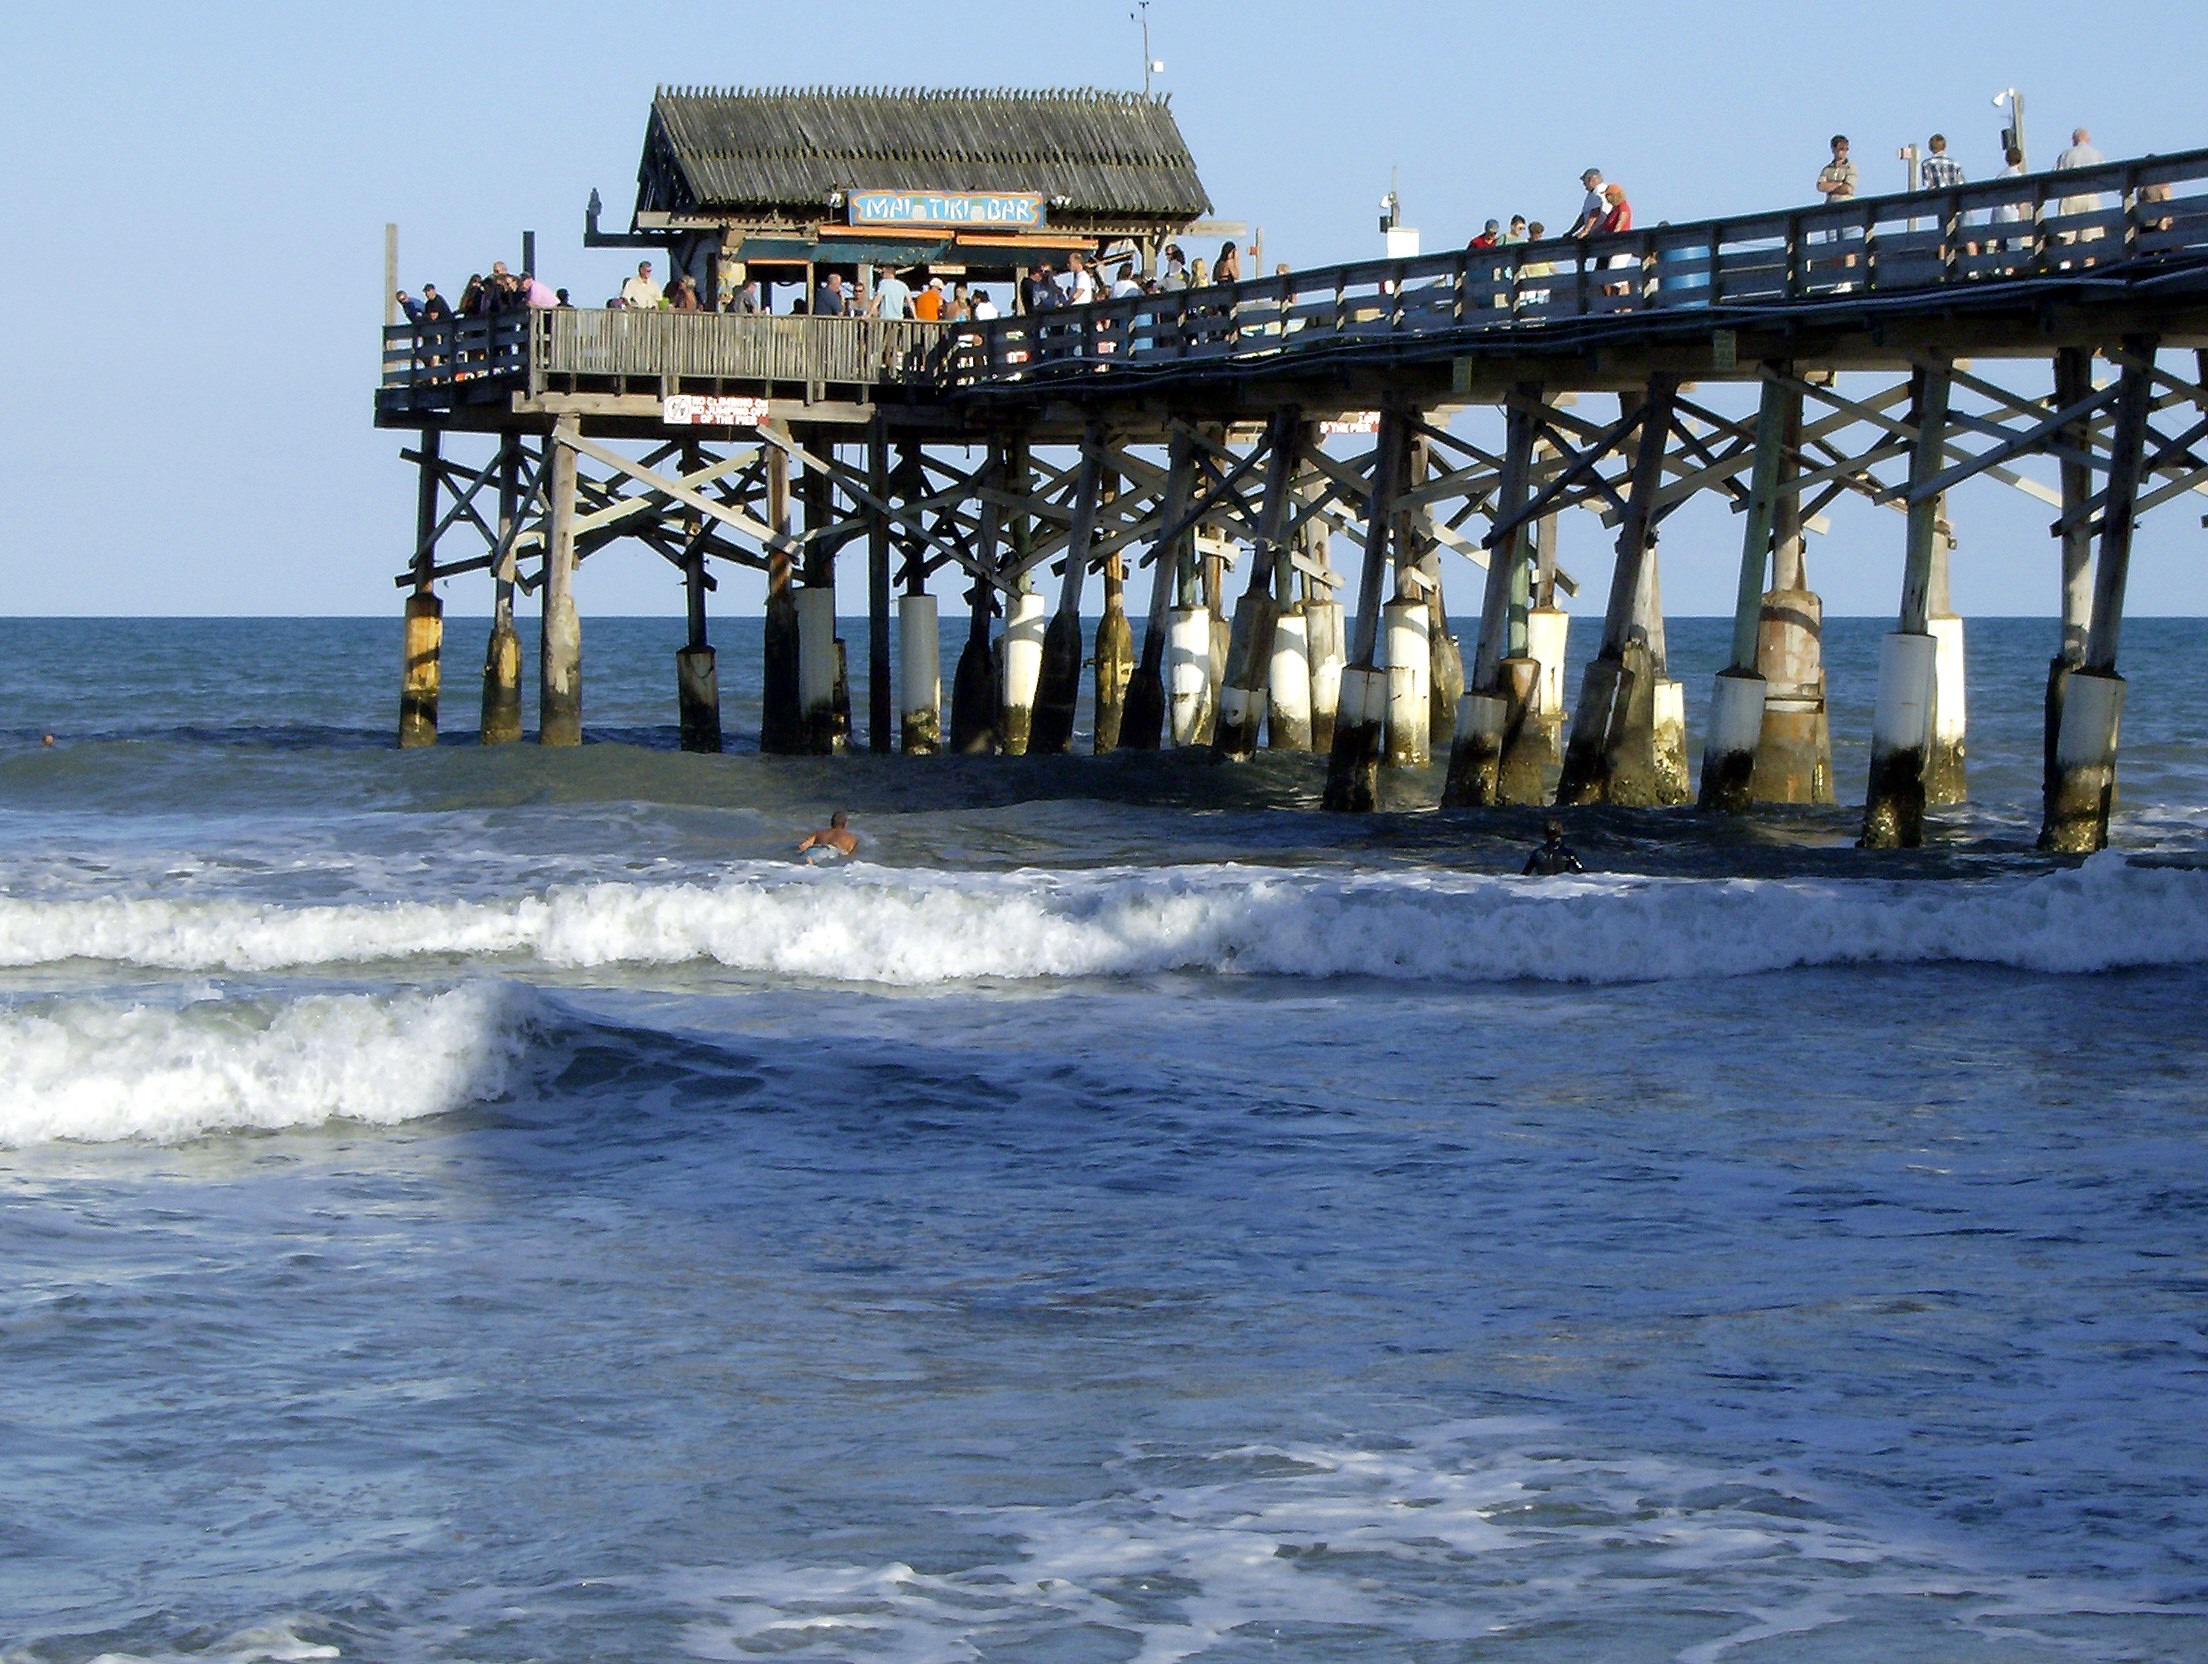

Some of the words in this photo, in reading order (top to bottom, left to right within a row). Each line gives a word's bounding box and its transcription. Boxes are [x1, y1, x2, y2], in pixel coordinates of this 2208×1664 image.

[866, 197, 910, 219] MAI
[929, 198, 969, 219] TIKI
[987, 199, 1029, 221] BAR
[715, 415, 734, 424] THE
[736, 415, 757, 425] PIER
